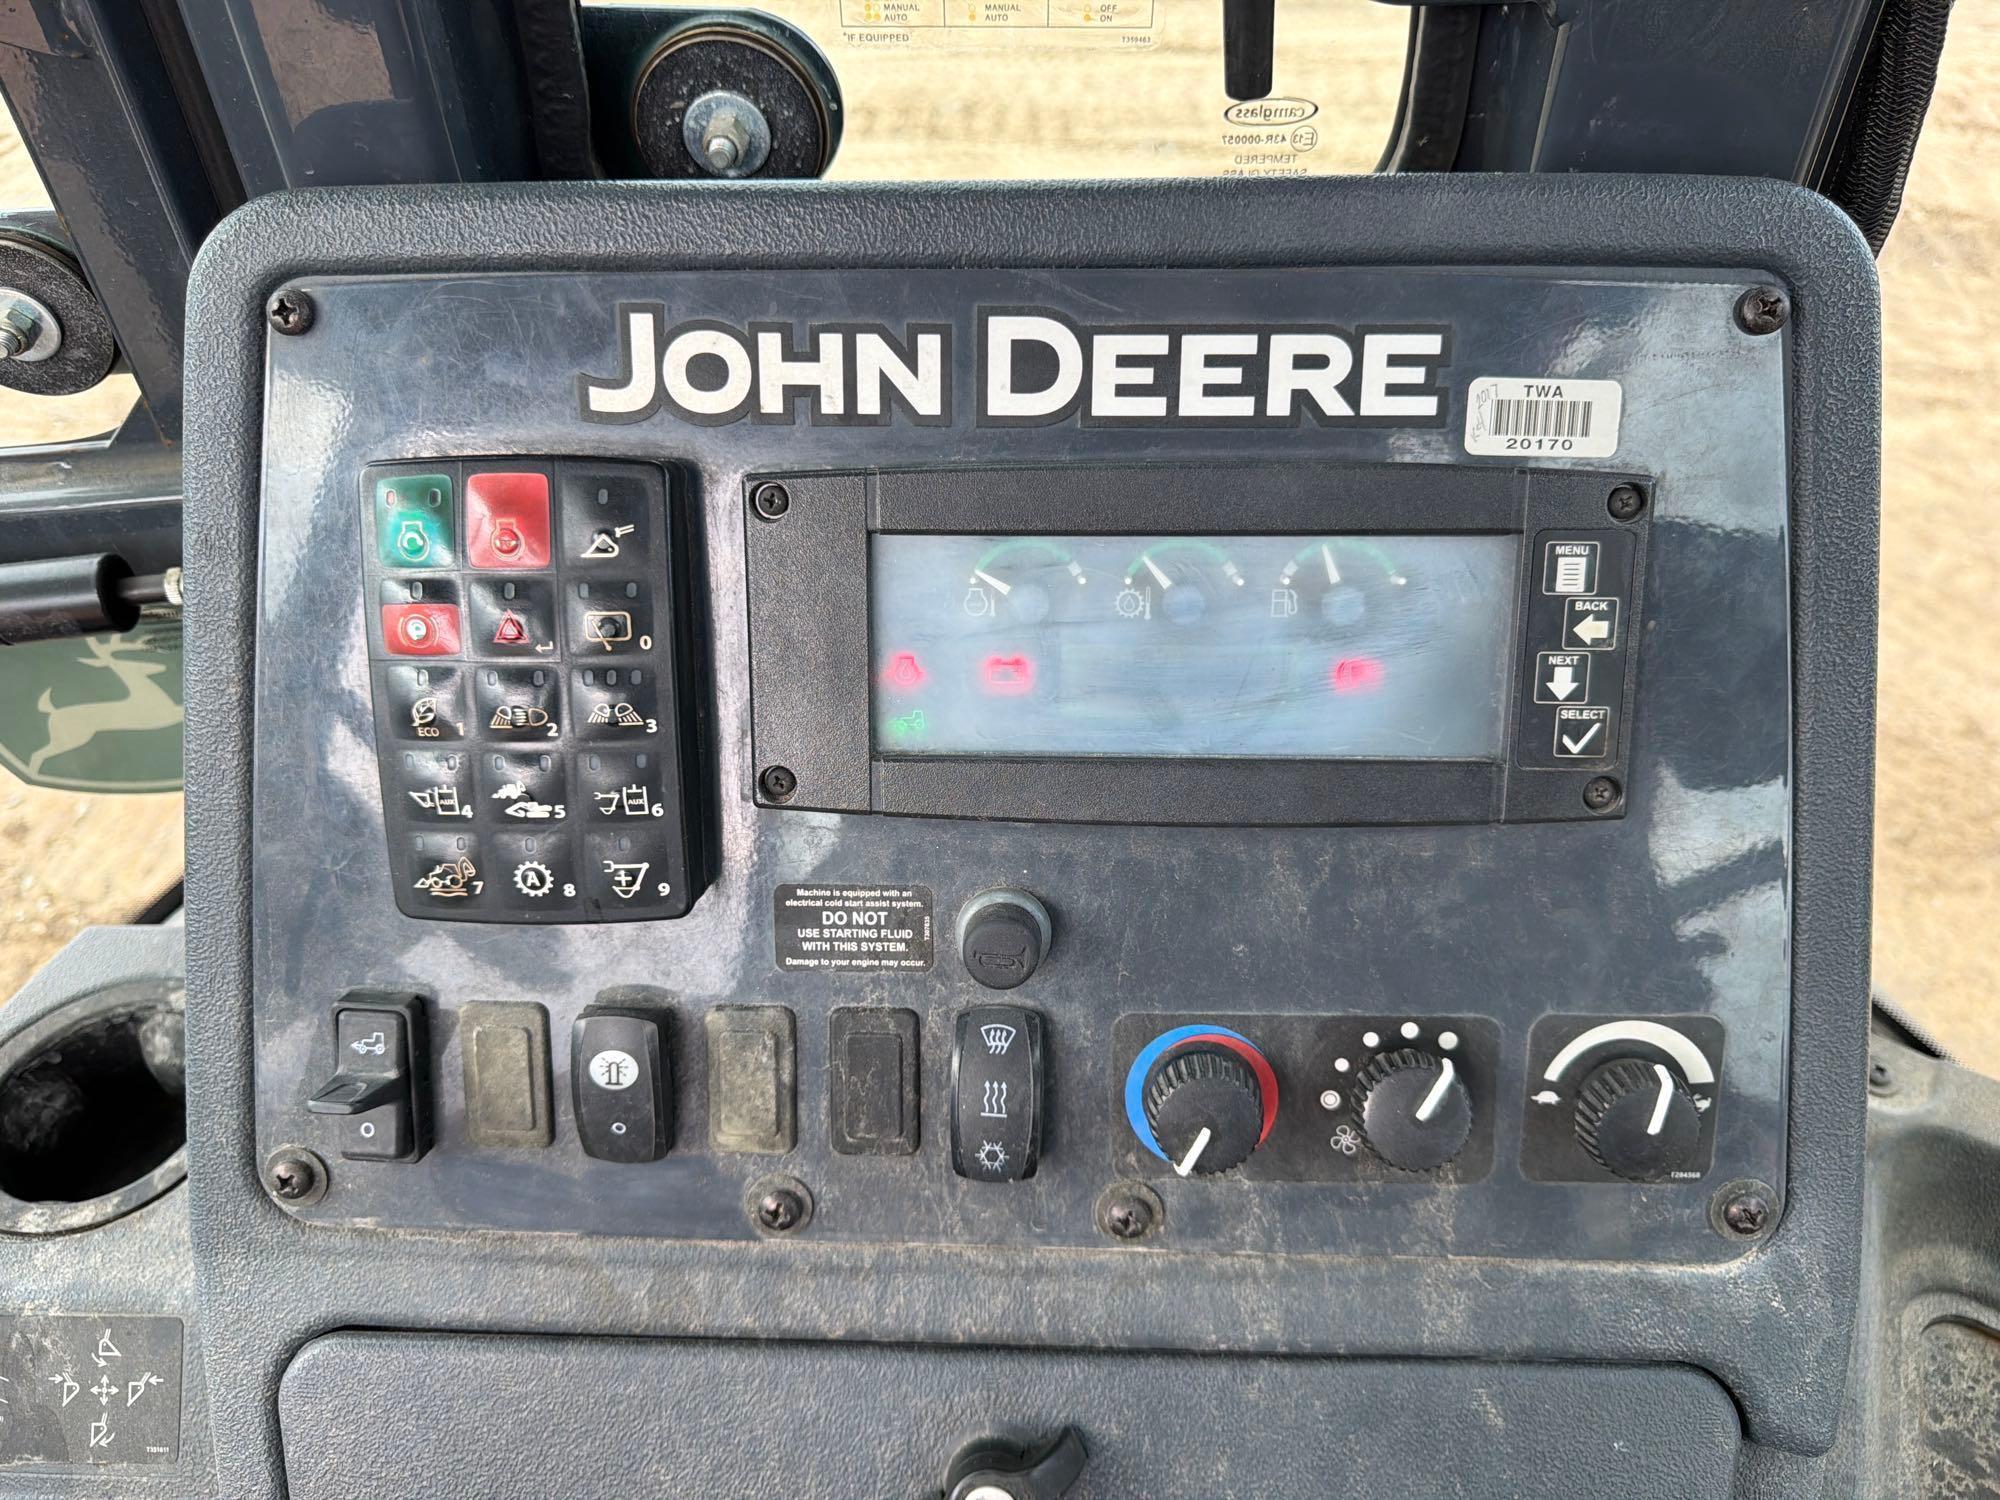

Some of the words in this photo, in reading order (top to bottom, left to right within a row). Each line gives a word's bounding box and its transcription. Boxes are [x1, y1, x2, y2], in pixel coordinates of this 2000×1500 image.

[883, 4, 920, 12] MANUAL
[984, 4, 1021, 12] MANUAL
[1100, 4, 1117, 12] OFF
[884, 13, 908, 22] AUTO
[984, 14, 1009, 22] AUTO
[1100, 14, 1113, 22] ON
[859, 33, 909, 42] EQUIPPED
[588, 311, 942, 416] JOHN
[987, 315, 1443, 417] DEERE
[1524, 384, 1564, 399] TWA
[1506, 438, 1573, 450] 20170
[1555, 545, 1589, 556] MENU
[1575, 601, 1608, 611] BACK
[1548, 656, 1579, 666] NEXT
[1560, 709, 1605, 720] SELECT
[456, 722, 464, 737] 1
[546, 722, 559, 737] 2
[646, 718, 658, 733] 3
[417, 727, 440, 737] ECO
[439, 798, 455, 806] AUX
[627, 798, 644, 806] AUX
[461, 804, 473, 818] 4
[554, 805, 566, 818] 5
[651, 804, 664, 817] 6
[527, 871, 540, 887] A
[472, 881, 484, 895] 7
[563, 884, 576, 897] 8
[657, 882, 670, 896] 9
[796, 888, 831, 897] Machine
[833, 888, 840, 897] is
[842, 888, 881, 899] equipped
[882, 889, 900, 897] with
[785, 898, 823, 907] electrical
[824, 899, 843, 907] cold
[844, 899, 863, 907] start
[865, 900, 890, 908] assist
[892, 900, 924, 909] system.
[822, 911, 848, 925] DO
[852, 911, 888, 926] NOT
[797, 928, 820, 938] USE
[822, 928, 878, 938] STARTING
[880, 929, 913, 939] FLUID
[802, 941, 830, 951] WITH
[832, 941, 858, 952] THIS
[861, 942, 909, 952] SYSTEM.
[785, 957, 819, 967] Damage
[820, 958, 830, 966] to
[831, 959, 850, 968] your
[851, 958, 879, 968] engine
[881, 960, 899, 968] may
